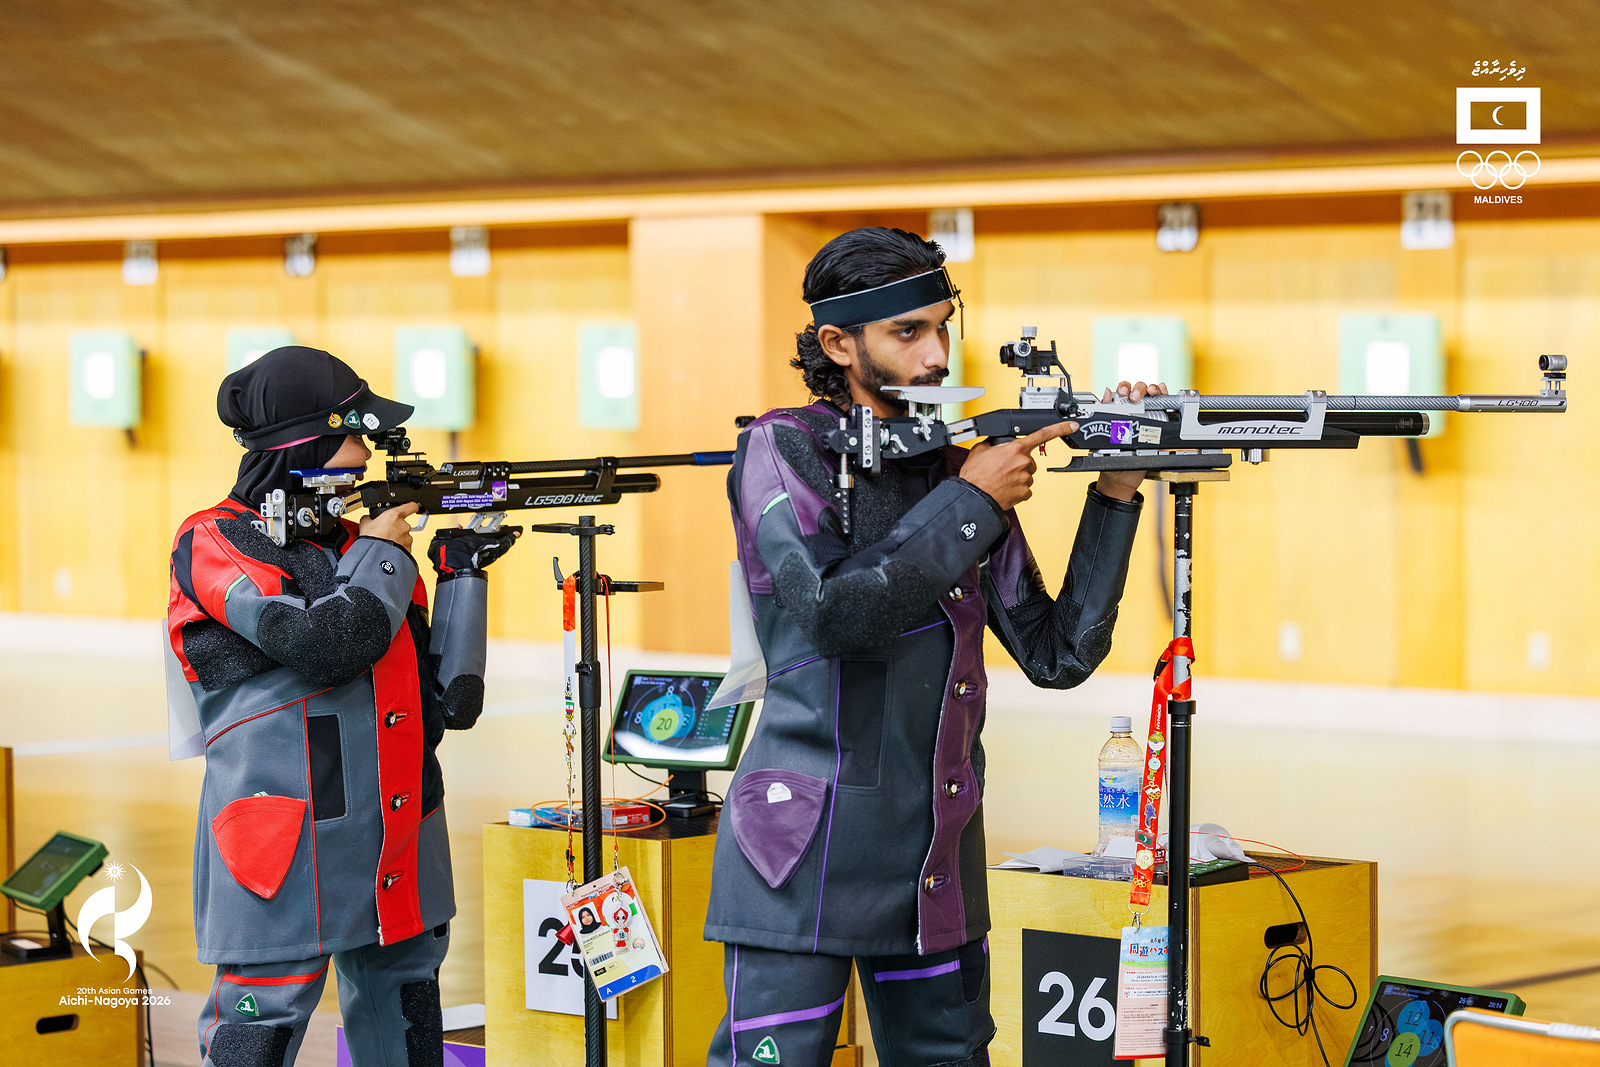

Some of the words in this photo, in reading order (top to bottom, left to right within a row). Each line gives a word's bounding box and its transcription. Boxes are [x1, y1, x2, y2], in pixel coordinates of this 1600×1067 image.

[1498, 399, 1539, 407] LG400
[1217, 423, 1304, 435] monotec
[453, 469, 479, 477] LG500
[525, 494, 574, 506] LG500
[574, 493, 603, 503] itec
[665, 685, 675, 697] 8
[634, 711, 643, 724] 8
[656, 717, 673, 731] 20
[630, 975, 637, 984] 2
[606, 987, 612, 995] A
[1038, 971, 1116, 1041] 26
[1404, 1010, 1422, 1026] 12
[1380, 1028, 1390, 1042] 8
[1420, 1030, 1435, 1045] 11
[1395, 1042, 1413, 1058] 14
